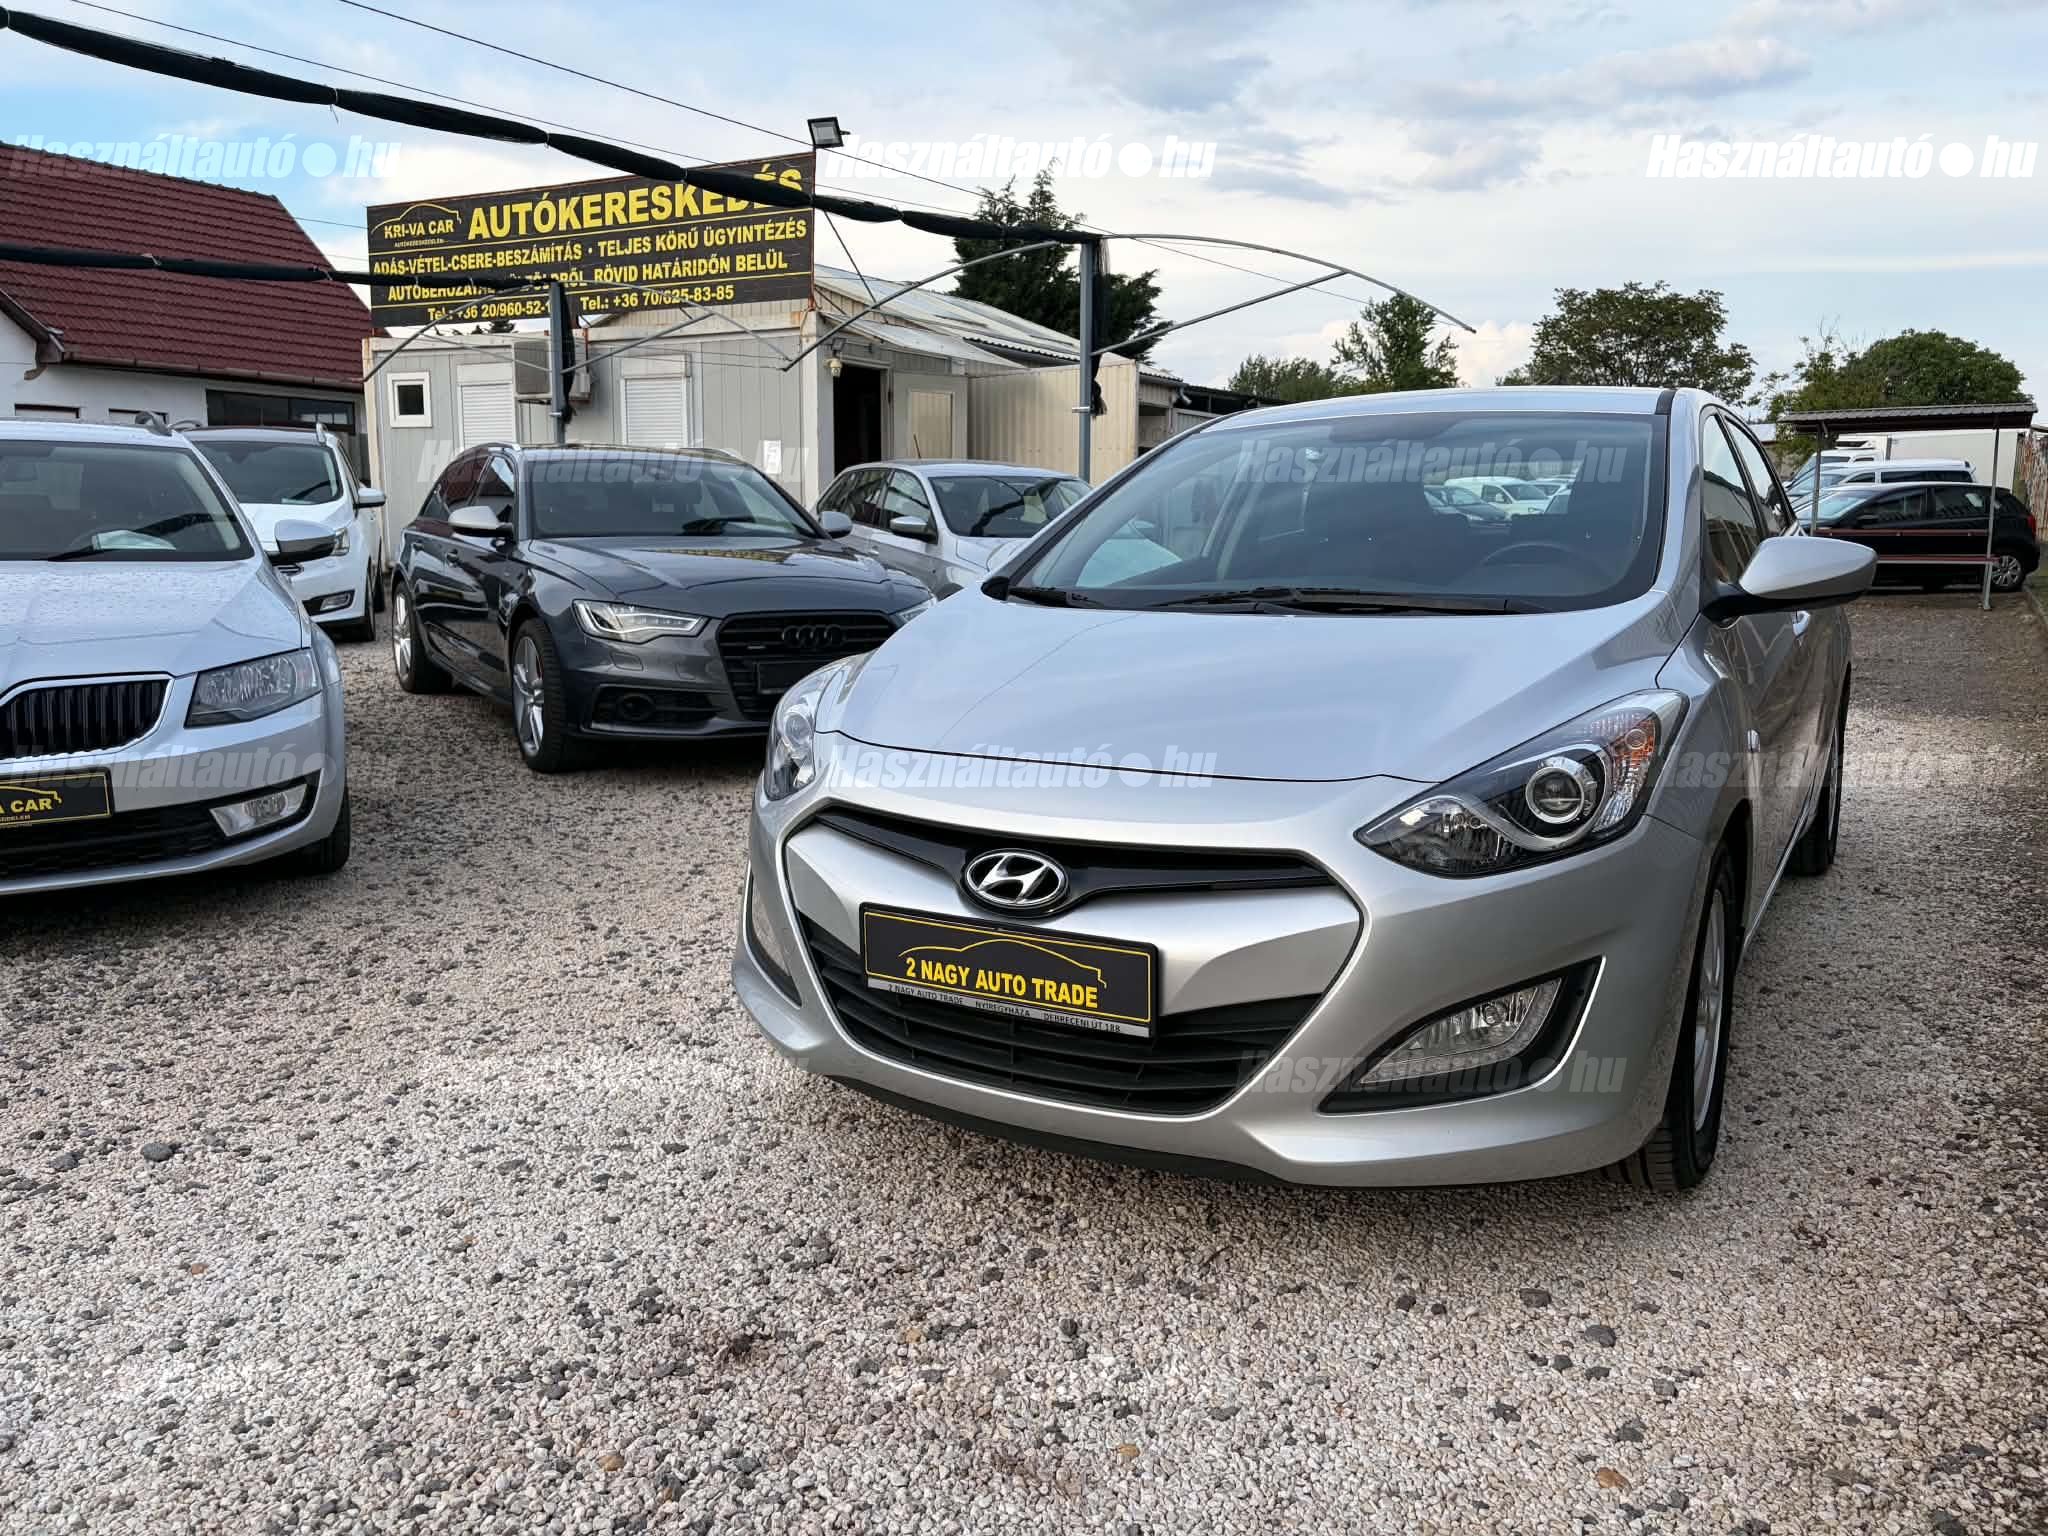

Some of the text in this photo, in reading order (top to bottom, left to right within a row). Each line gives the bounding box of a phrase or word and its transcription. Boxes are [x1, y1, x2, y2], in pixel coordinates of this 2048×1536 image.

[384, 220, 454, 240] KRI-VA CAR
[598, 236, 652, 257] TELJES
[655, 226, 698, 252] KÖRŰ
[703, 216, 807, 247] ÜGYINTÉZÉS
[594, 264, 639, 285] RÖVID
[642, 253, 730, 281] HATÁRIDŐN
[735, 248, 788, 272] BELÜL
[481, 300, 552, 318] 20/960-52-1
[580, 295, 609, 310] Tel.:
[613, 292, 639, 307] +36
[642, 284, 734, 306] 70/625-83-85
[10, 797, 53, 814] CAR
[895, 985, 915, 996] NAGY
[916, 989, 938, 1000] AUTO
[906, 957, 1099, 1008] 2 NAGY AUTO TRADE
